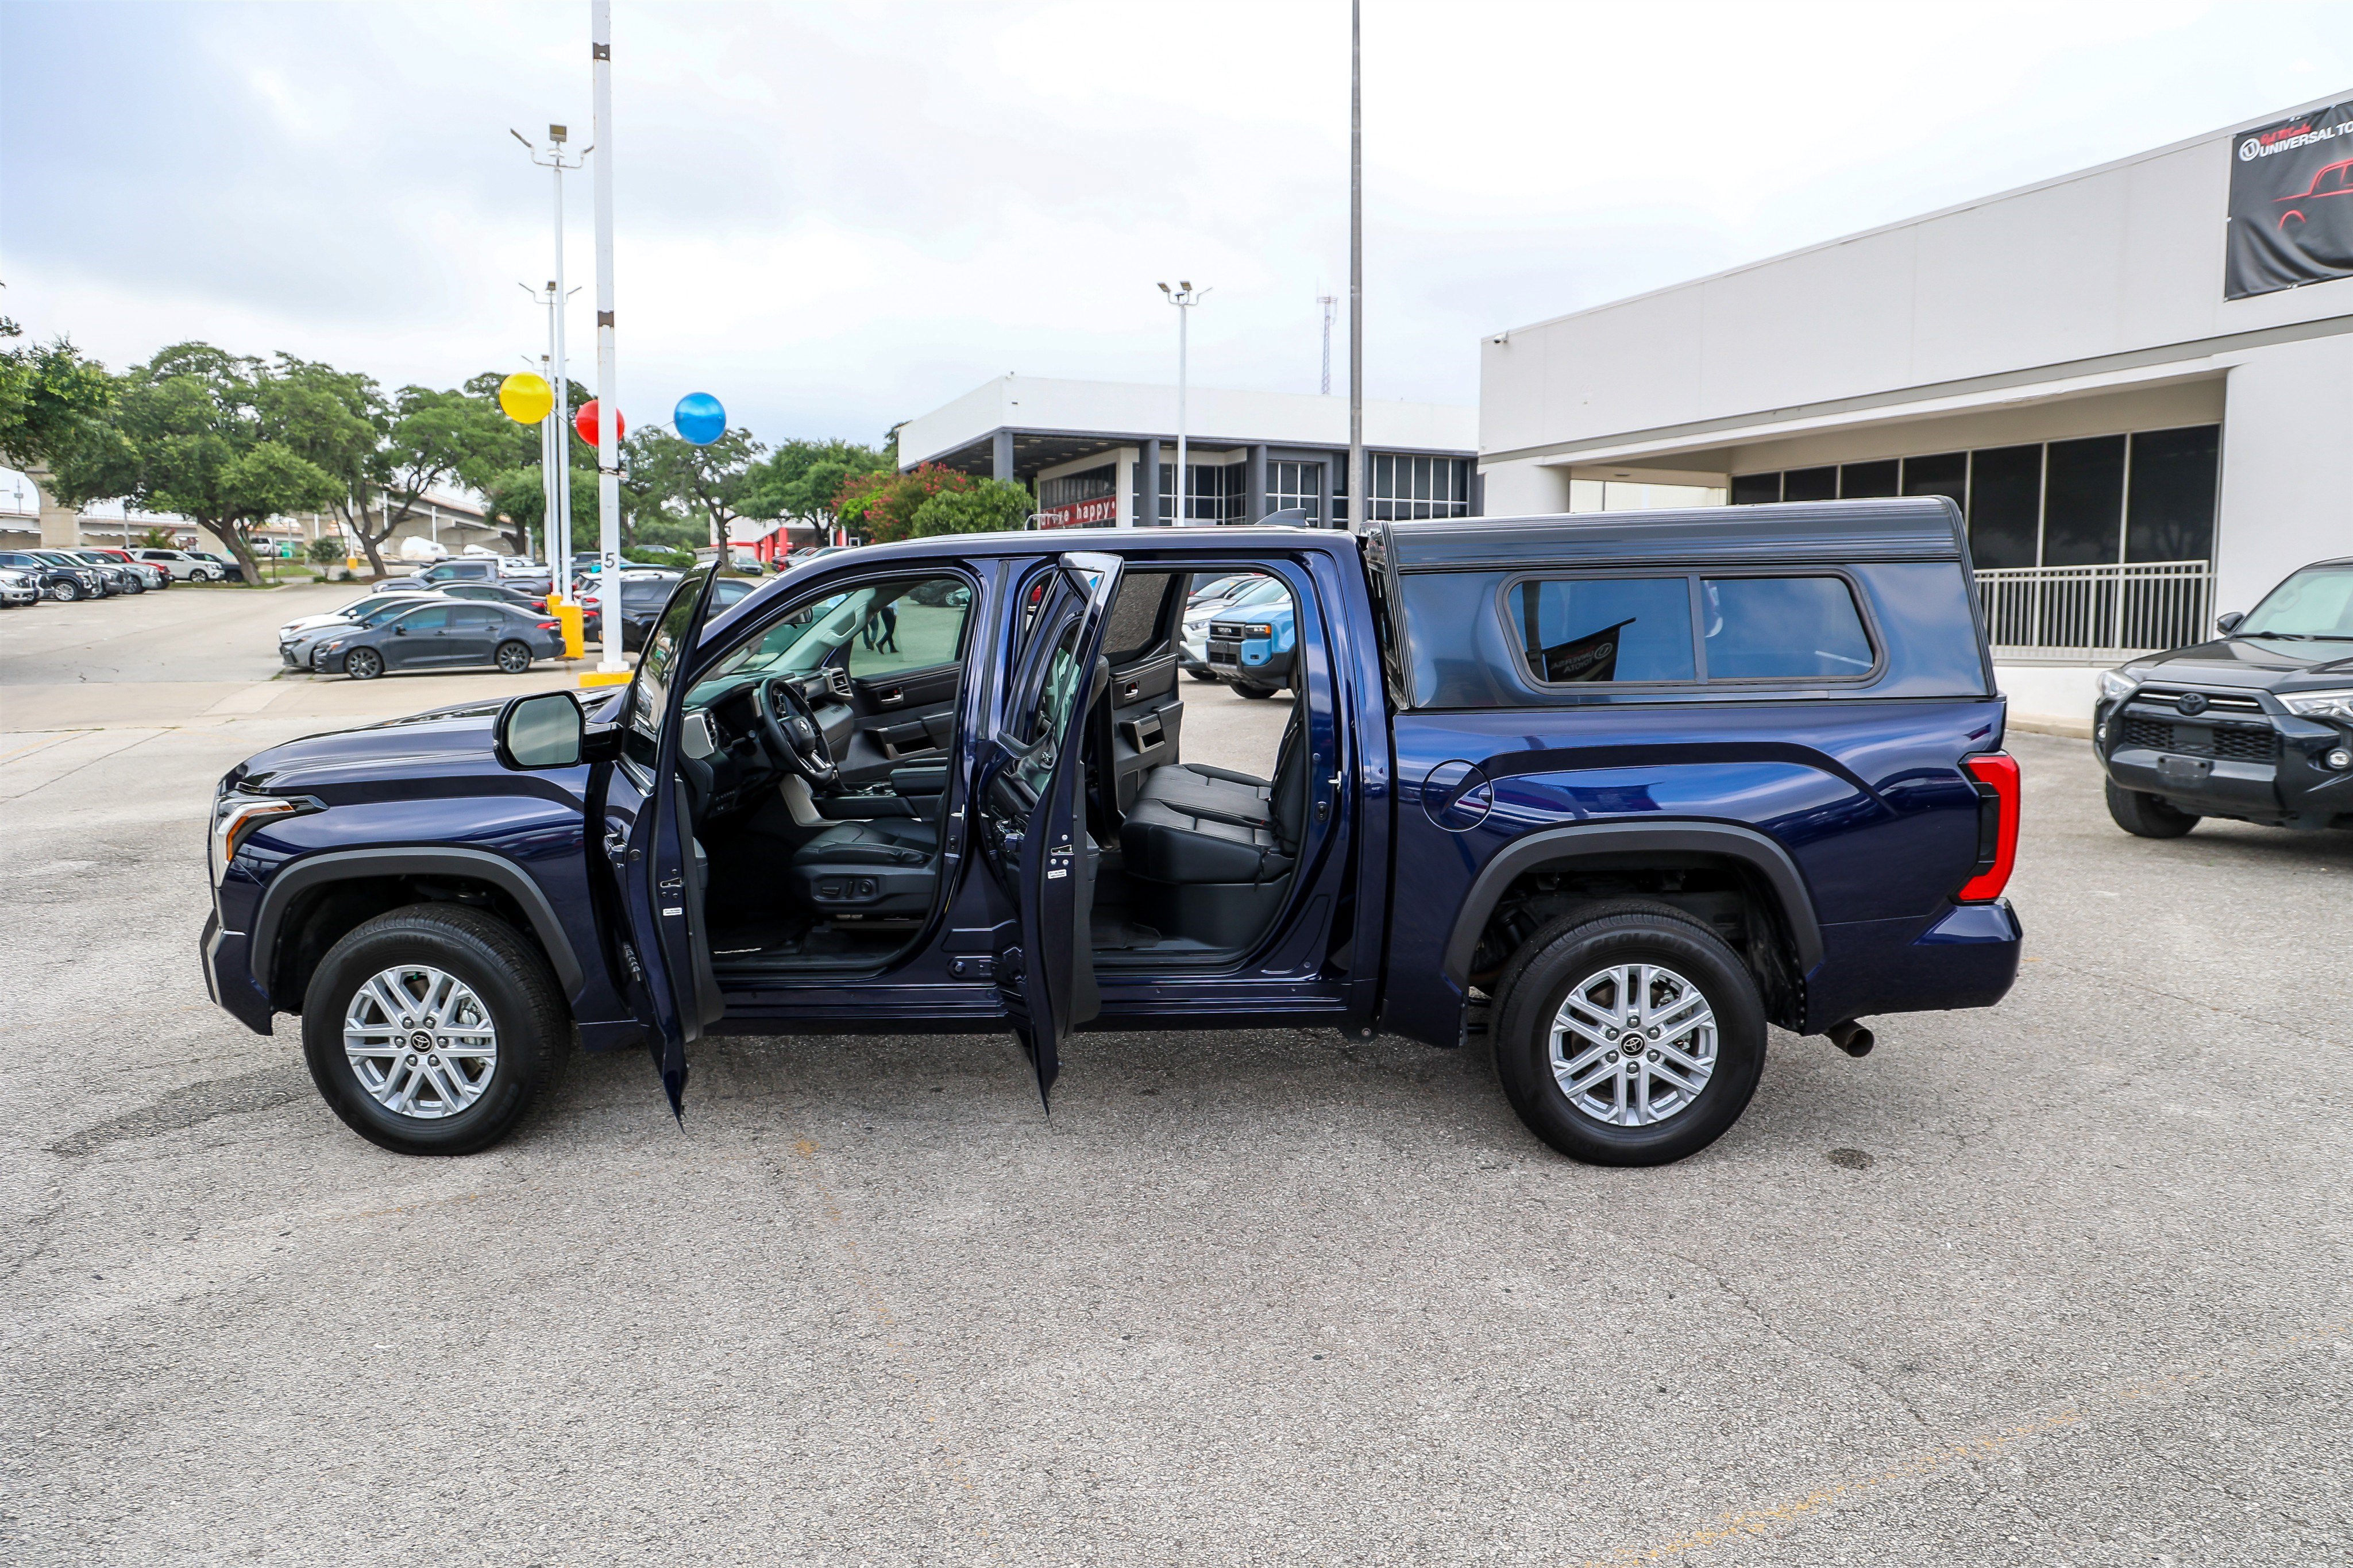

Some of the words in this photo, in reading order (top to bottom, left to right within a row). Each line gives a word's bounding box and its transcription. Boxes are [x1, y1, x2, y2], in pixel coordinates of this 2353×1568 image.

[2259, 126, 2336, 157] UNIVERSAL
[1077, 501, 1110, 521] happy
[604, 552, 615, 568] 5
